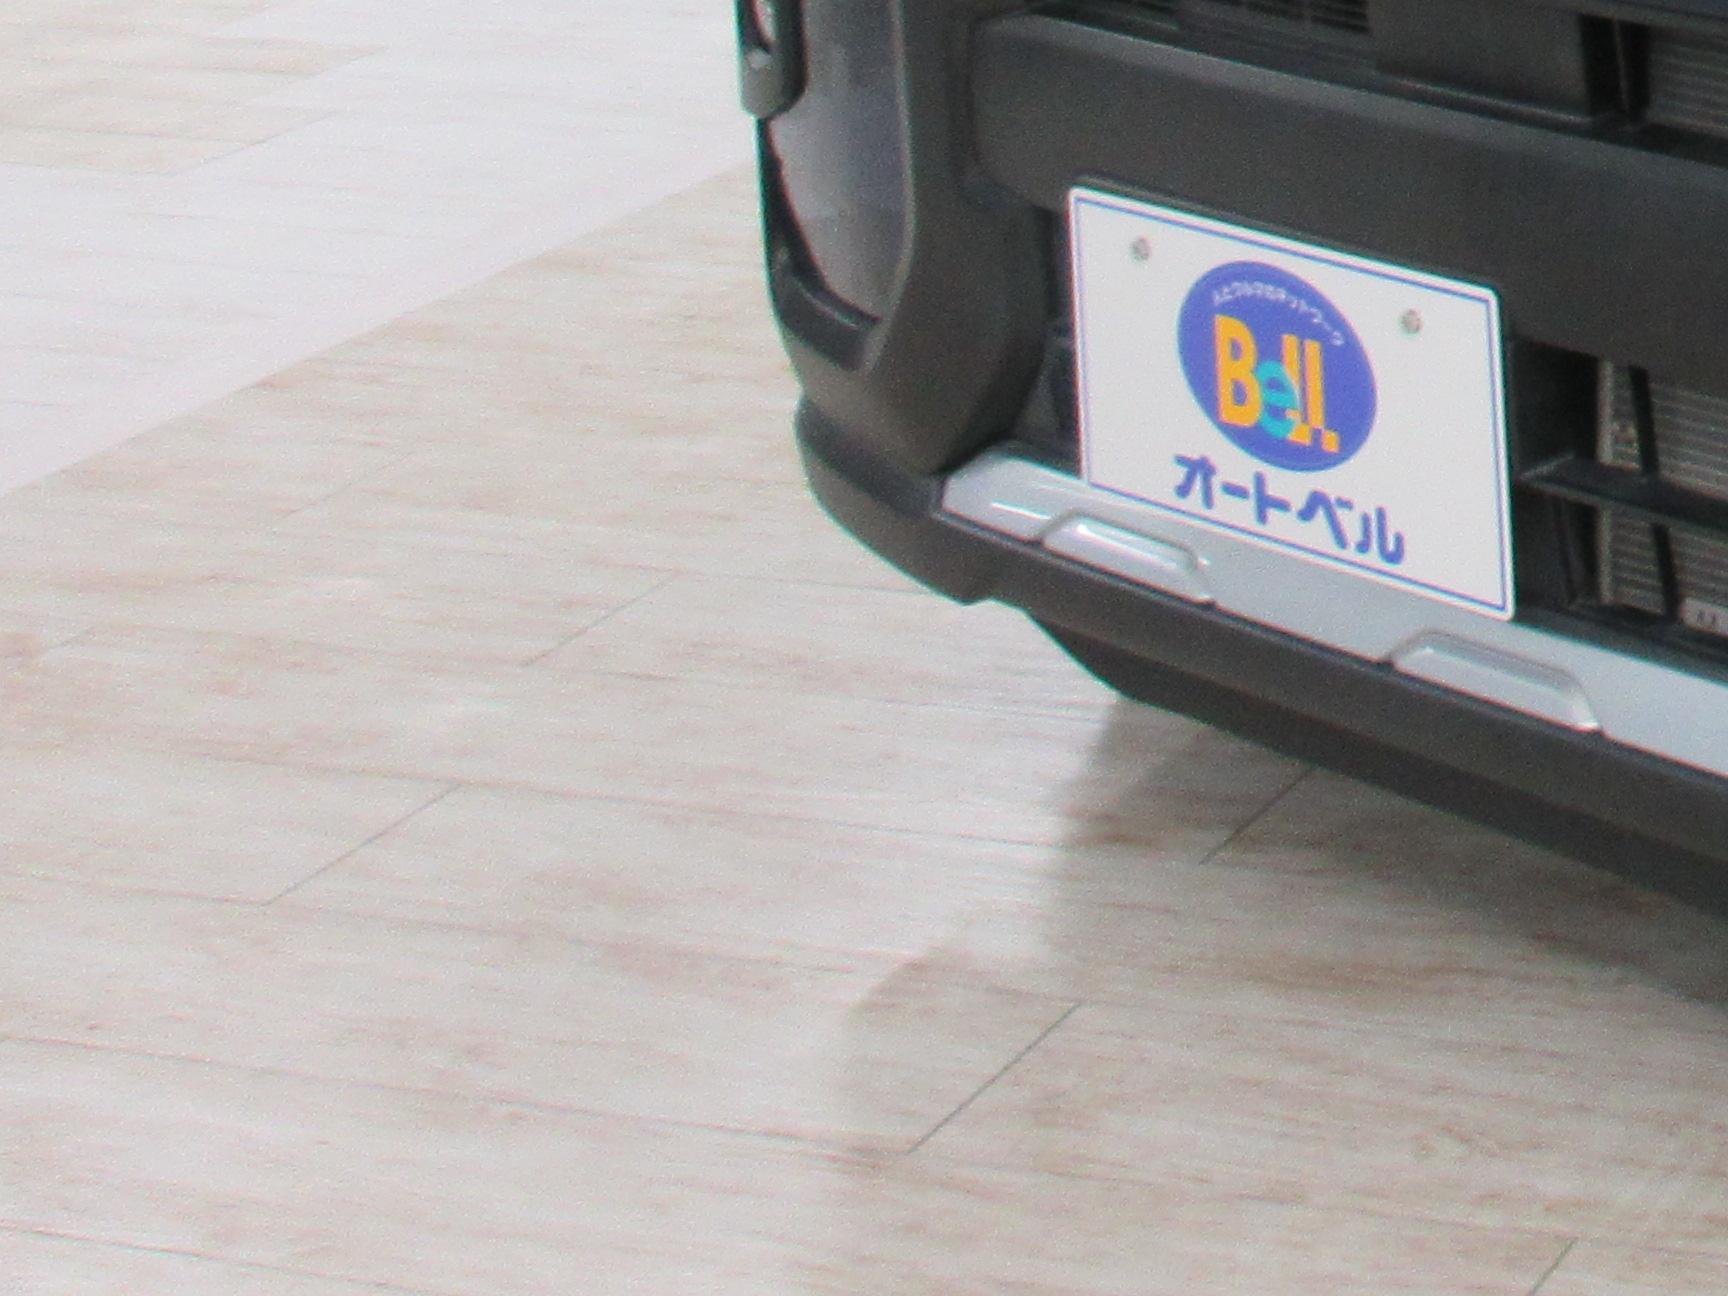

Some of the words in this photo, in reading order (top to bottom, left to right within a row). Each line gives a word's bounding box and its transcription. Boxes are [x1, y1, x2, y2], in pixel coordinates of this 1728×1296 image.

[1173, 454, 1405, 564] オートベル
